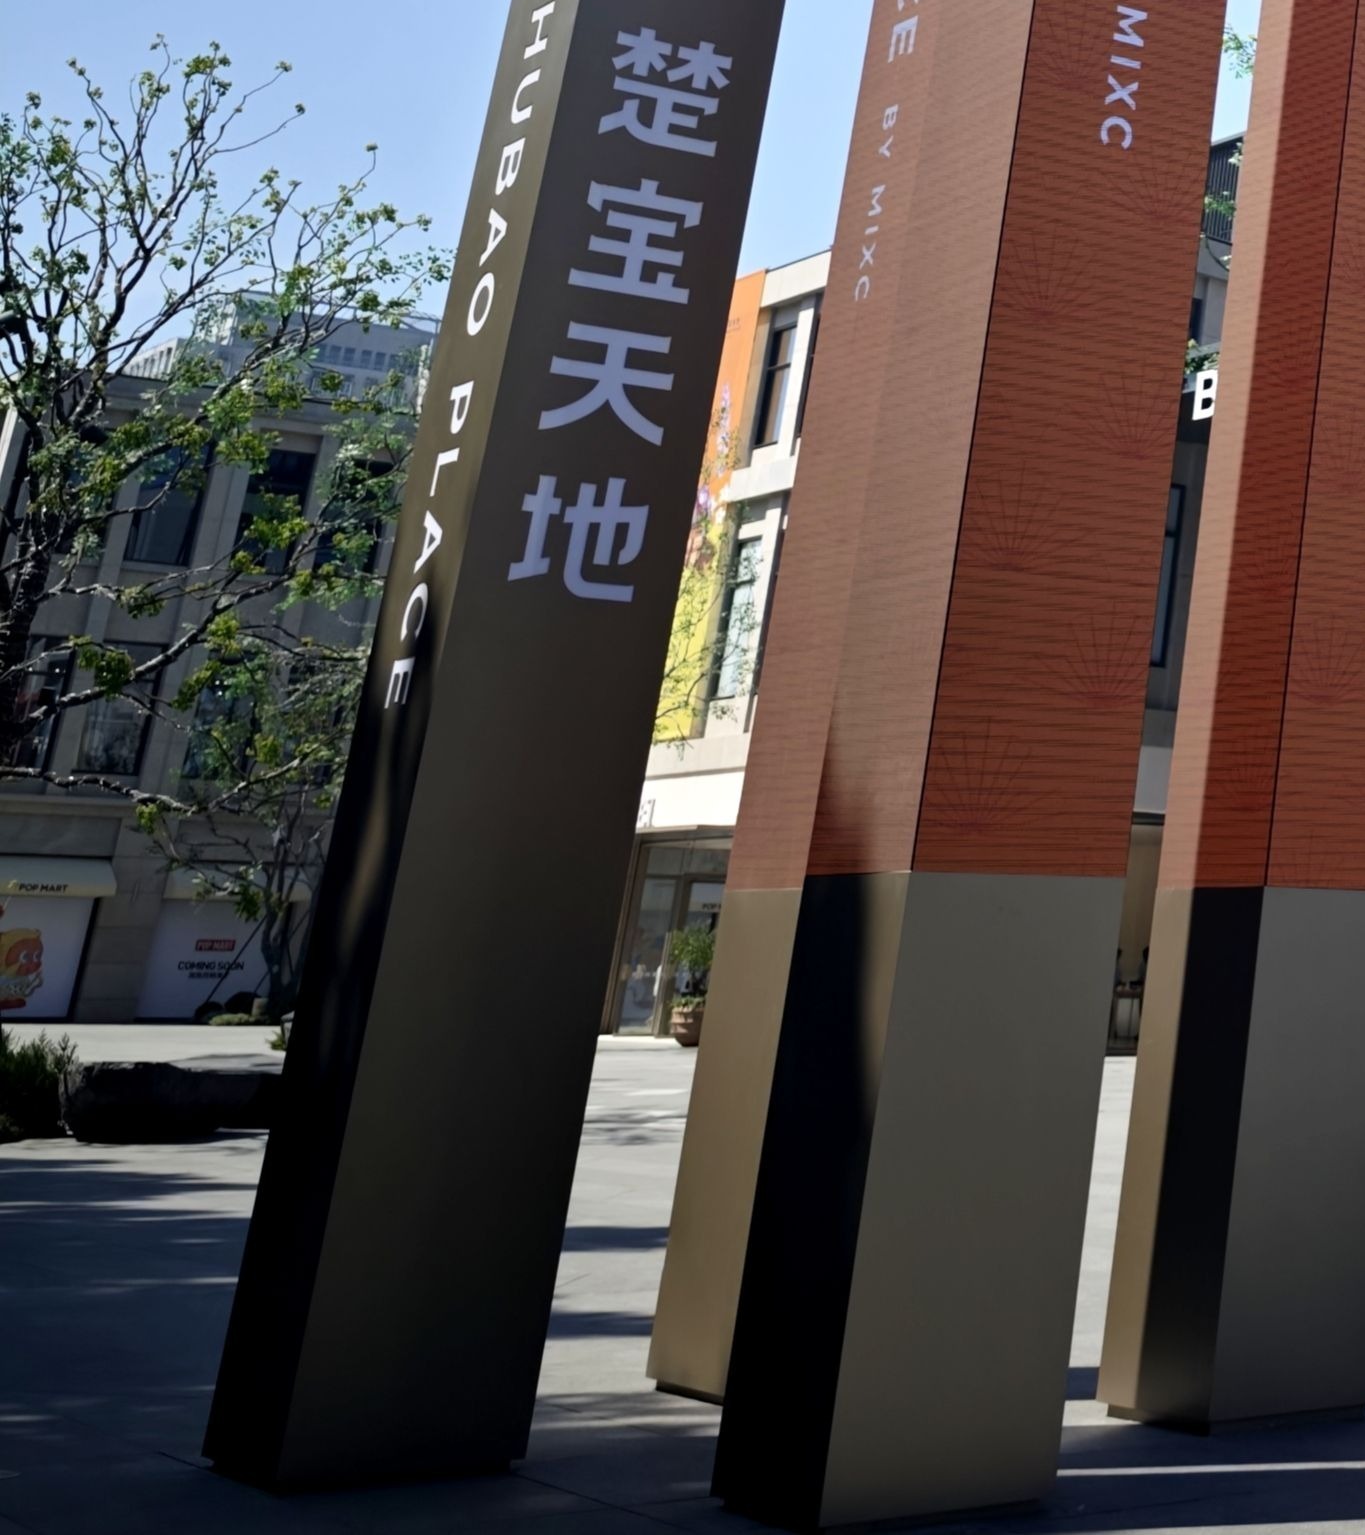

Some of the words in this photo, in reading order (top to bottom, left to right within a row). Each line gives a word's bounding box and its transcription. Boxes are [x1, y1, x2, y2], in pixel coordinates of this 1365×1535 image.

[876, 104, 899, 159] BY
[1100, 4, 1148, 151] MIXC
[854, 185, 885, 302] MIXC
[507, 26, 733, 603] 楚宝天地
[383, 380, 475, 711] PLACE
[19, 883, 39, 892] POP
[40, 884, 68, 892] MART
